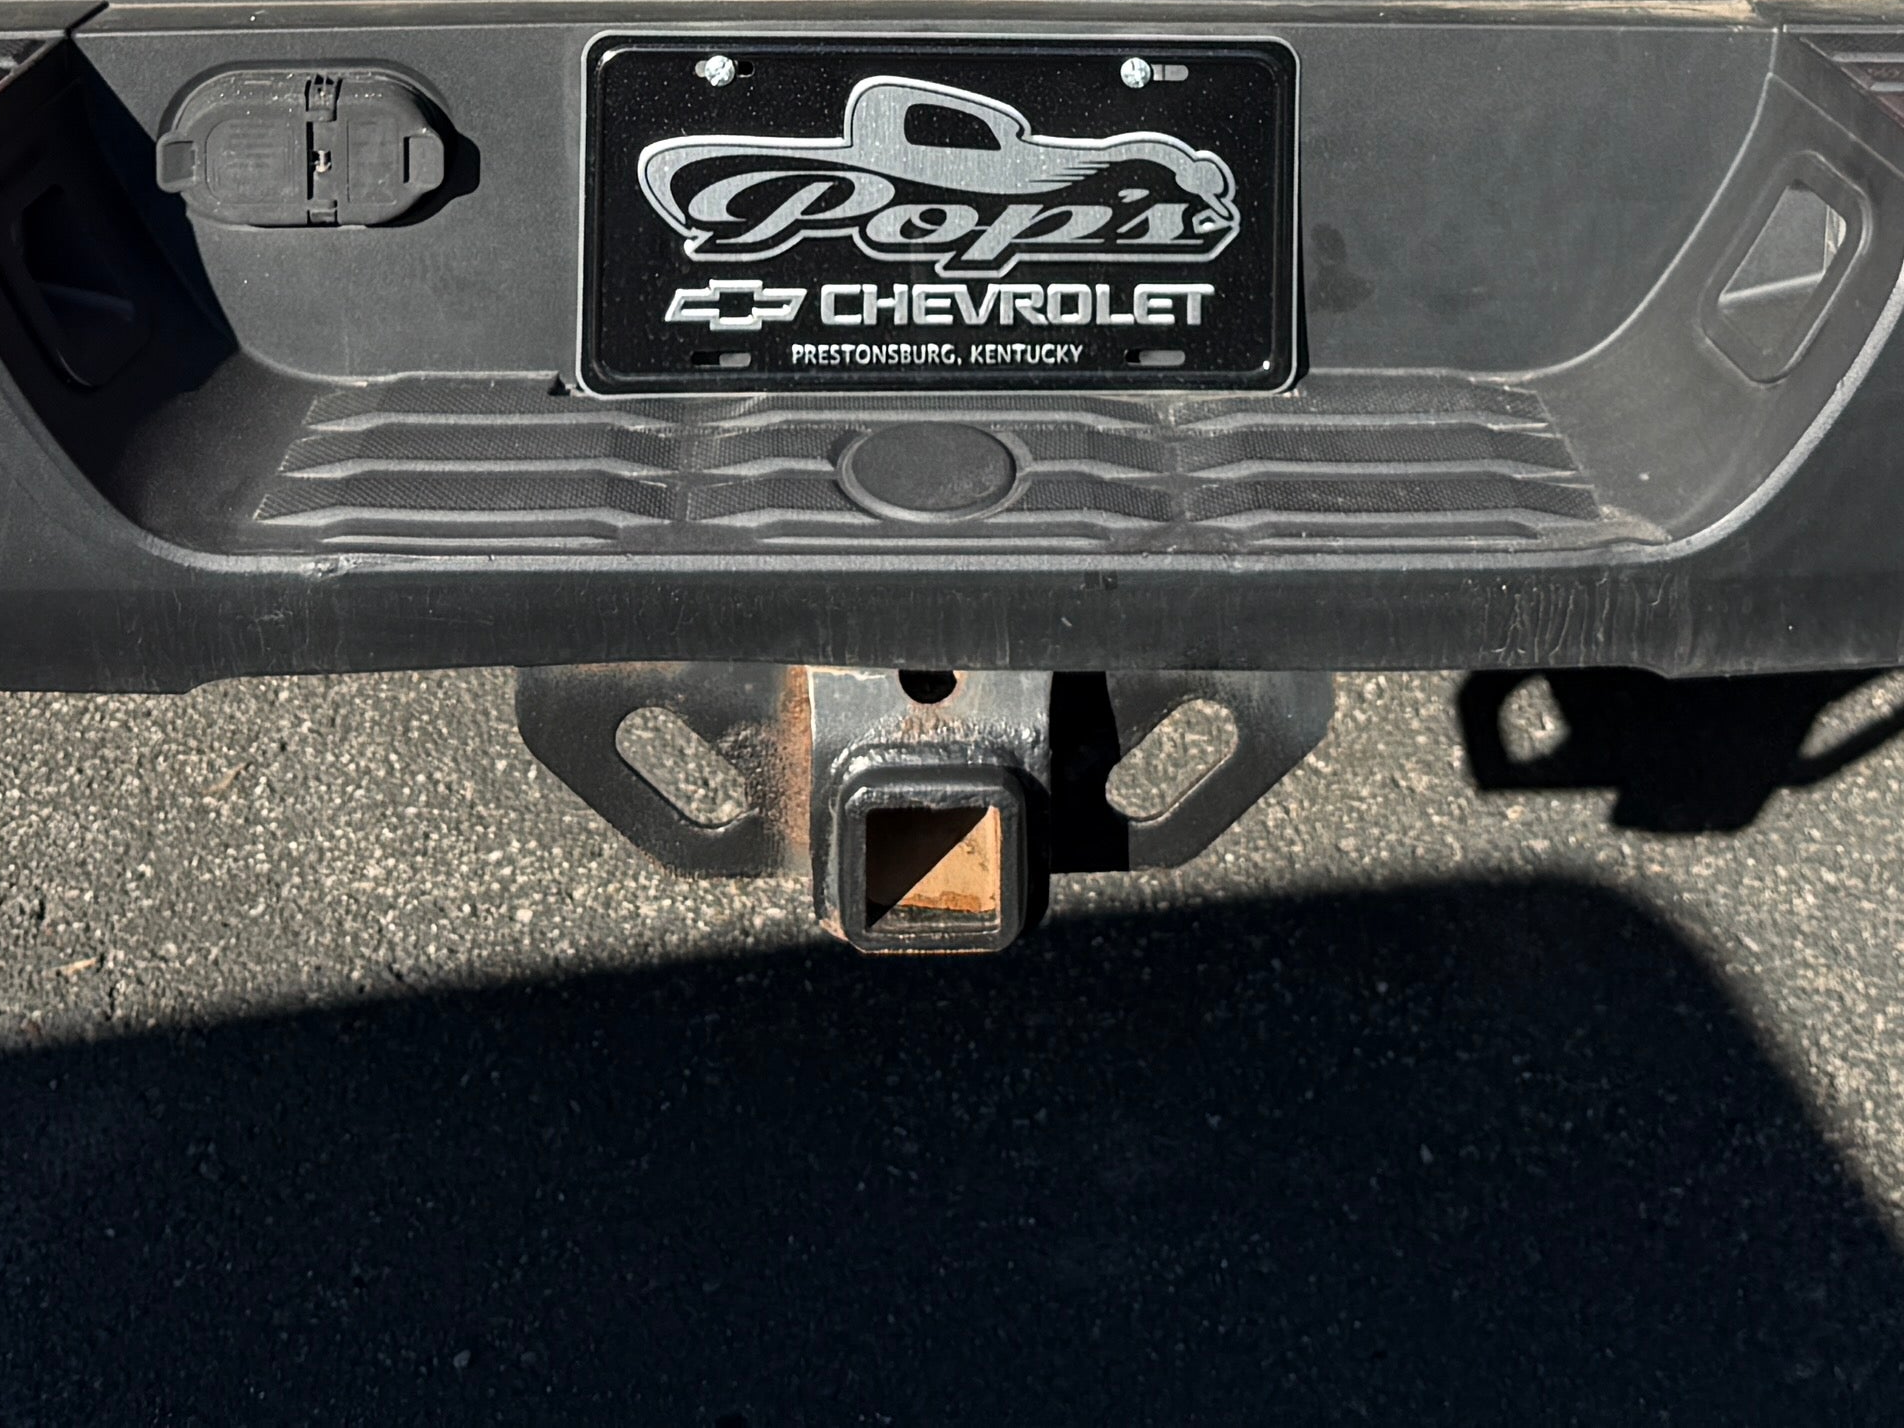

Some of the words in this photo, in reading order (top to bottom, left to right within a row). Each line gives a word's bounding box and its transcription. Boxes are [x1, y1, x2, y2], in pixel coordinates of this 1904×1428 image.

[820, 282, 1215, 327] CHEVROLET
[791, 343, 963, 367] PRESTONSBURG,
[970, 343, 1084, 365] KENTUCKY
